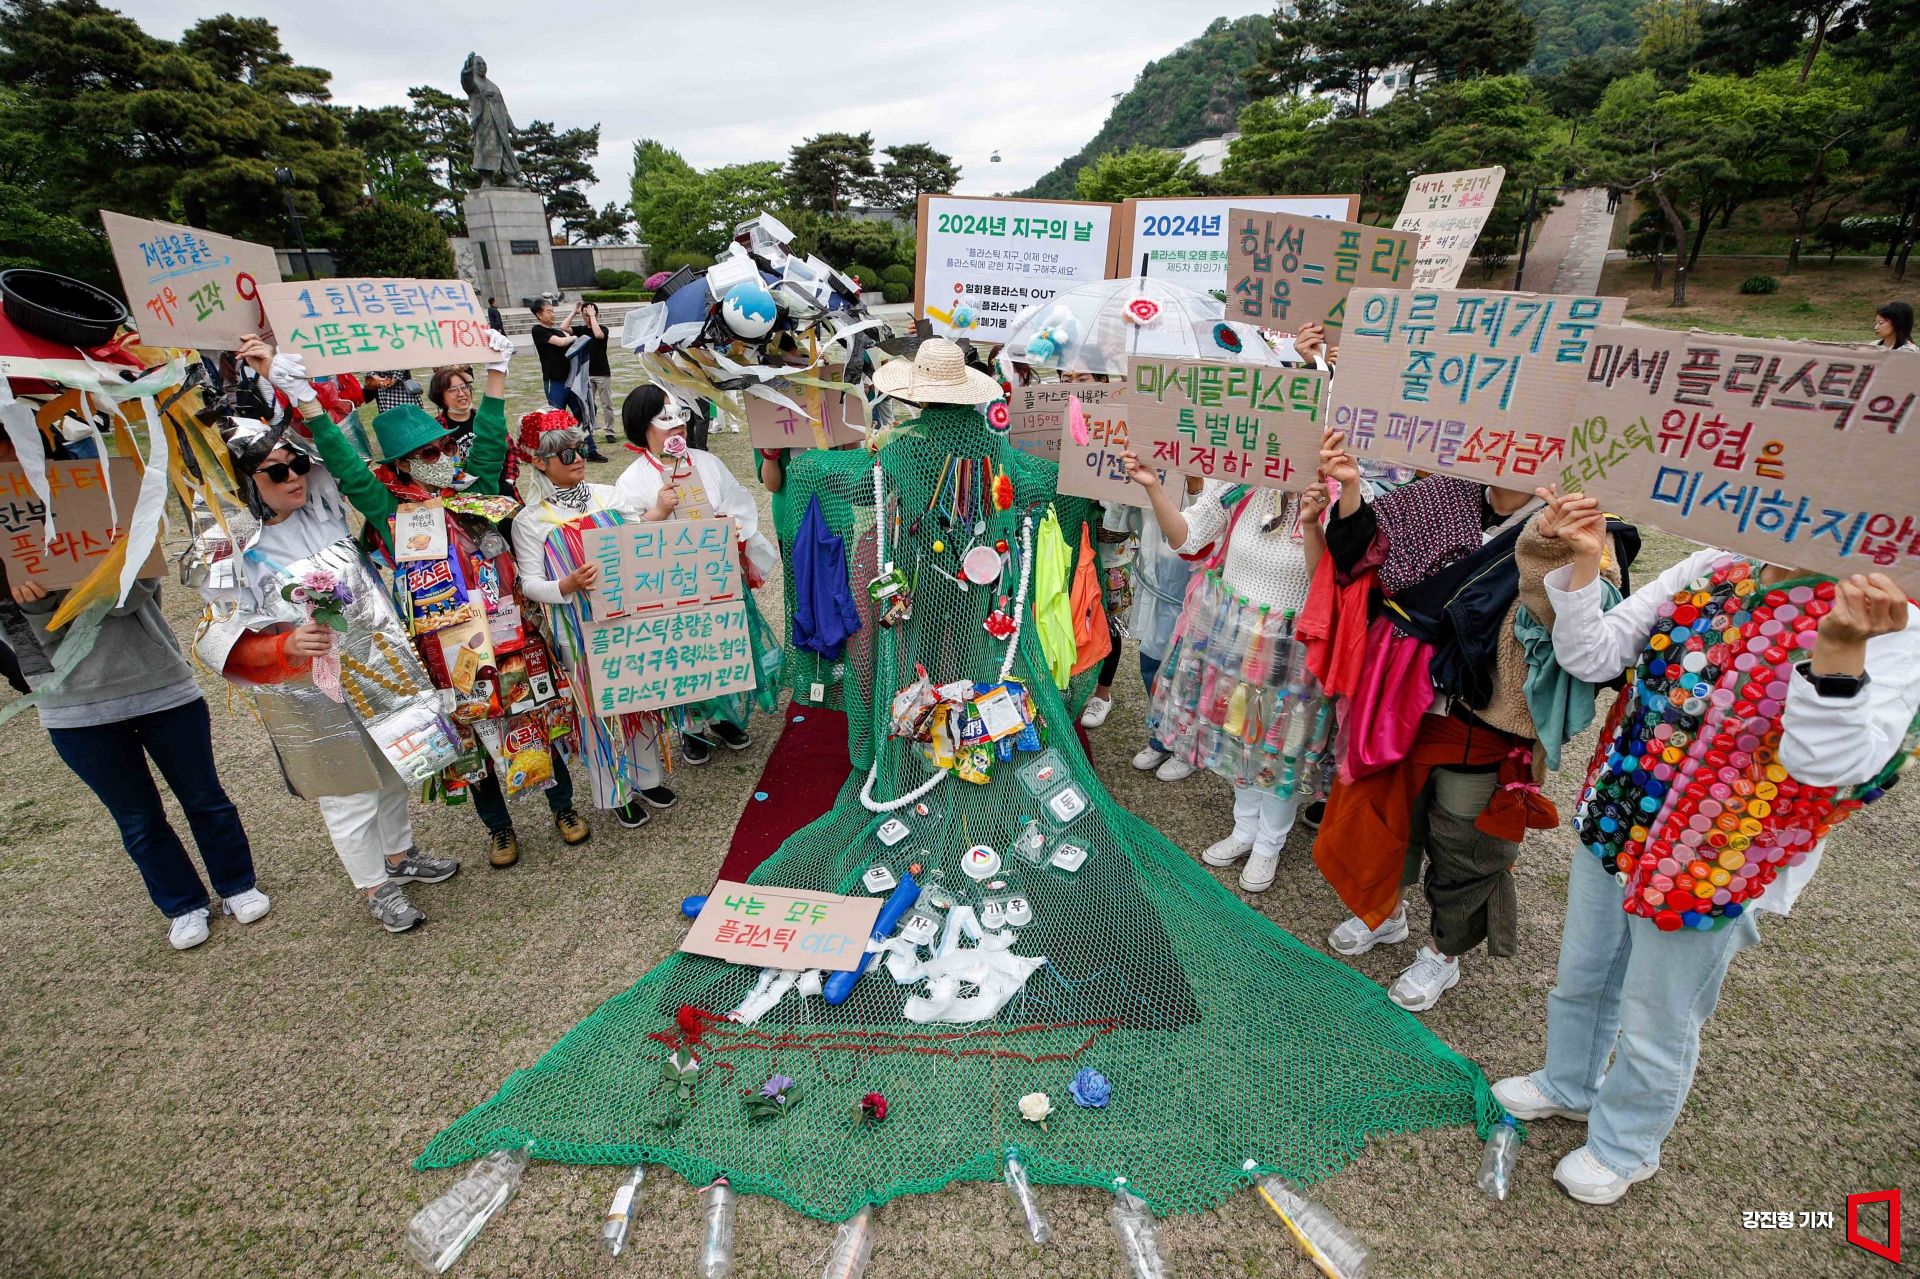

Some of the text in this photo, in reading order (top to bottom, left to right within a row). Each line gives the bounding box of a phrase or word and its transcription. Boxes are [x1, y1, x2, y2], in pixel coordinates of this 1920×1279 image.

[1451, 175, 1492, 192] 우리가
[938, 213, 1094, 242] 2024년 지구의 날
[1142, 215, 1221, 237] 2024년
[1239, 218, 1305, 274] 합성
[946, 258, 986, 270] 플라스틱에
[1006, 262, 1030, 273] 지구를
[1042, 253, 1059, 263] 안녕
[1150, 250, 1187, 261] 플라스틱
[1188, 250, 1208, 261] 오염
[1166, 262, 1191, 273] 제5차
[1193, 262, 1221, 274] 회의가
[188, 280, 226, 323] 고작
[965, 283, 1057, 300] 일회용플라스틱 OUT
[1233, 275, 1293, 321] 섬유
[1354, 293, 1603, 365] 의류 폐기물
[1136, 363, 1324, 423] 미세플라스틱
[1400, 350, 1522, 411] 줄이기
[1587, 344, 1918, 435] 미세 플라스틱의
[1333, 406, 1378, 451] 의류
[1384, 412, 1467, 468] 폐기물
[1571, 415, 1609, 459] NO
[1656, 408, 1785, 480] 위협은
[1152, 440, 1296, 482] 제정하라
[596, 525, 730, 577] 플라스틱
[408, 560, 453, 593] 포스틱
[602, 560, 734, 611] 국제협약
[724, 894, 829, 927] 나는 모두
[714, 918, 797, 953] 플라스틱
